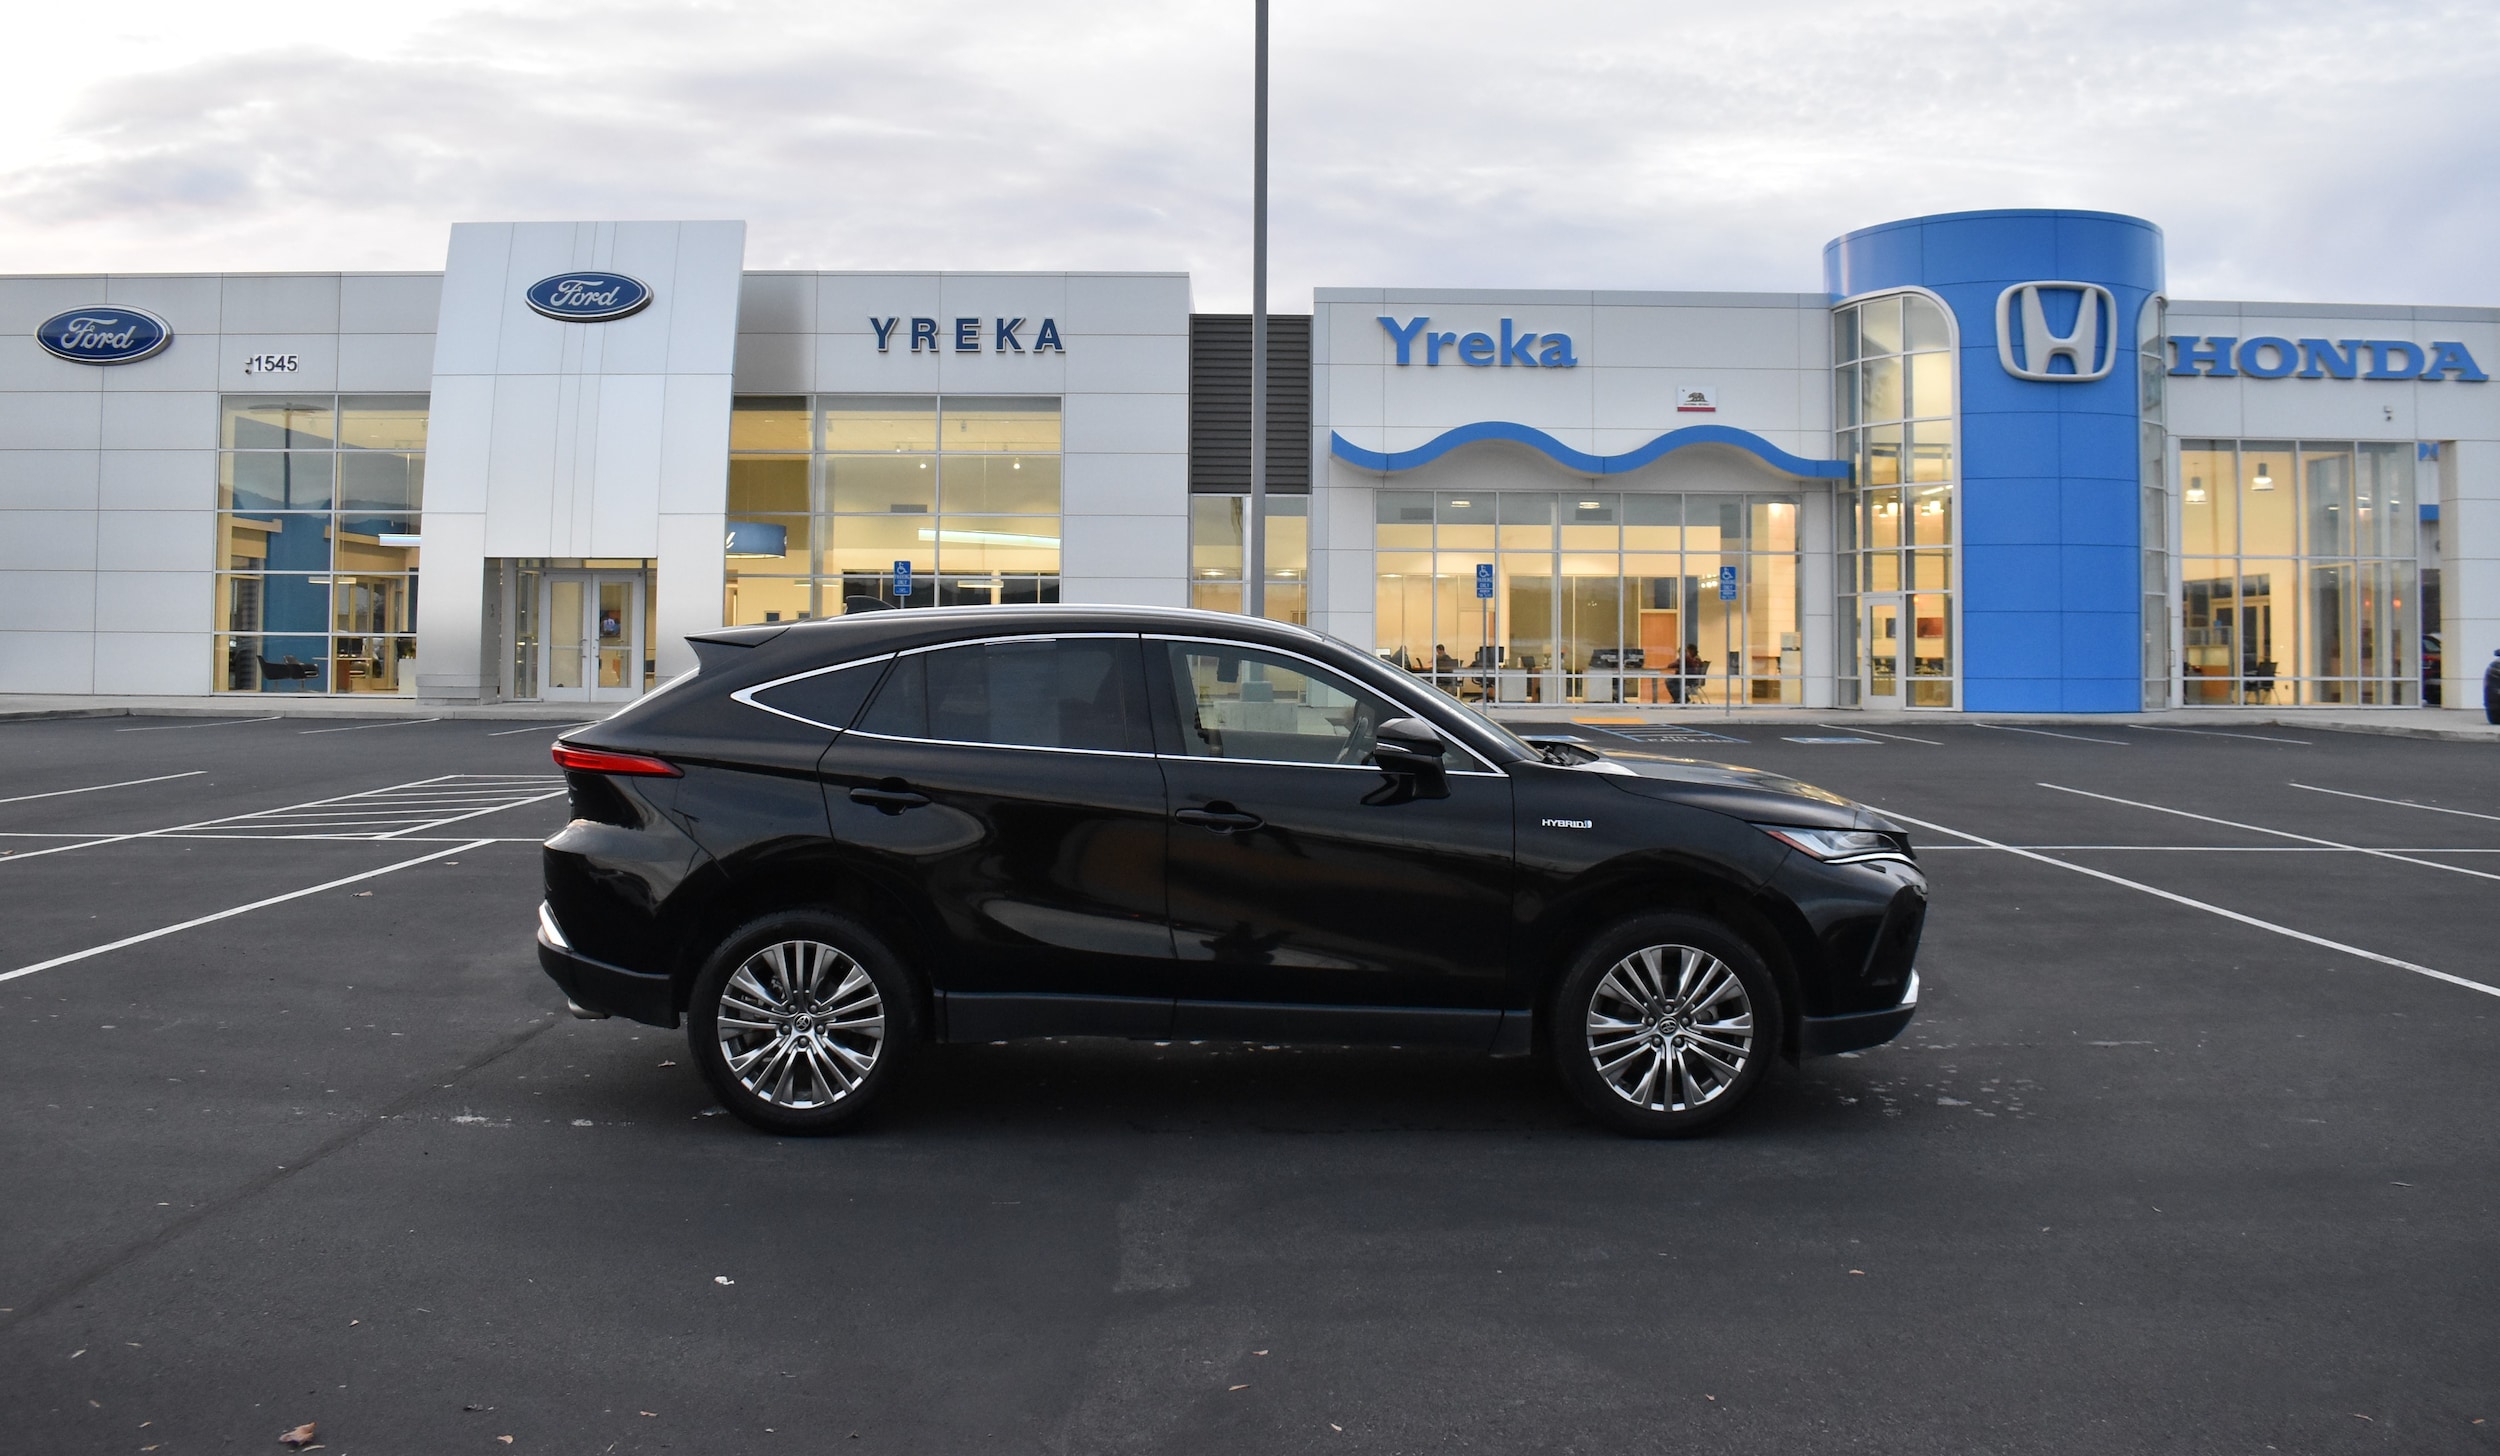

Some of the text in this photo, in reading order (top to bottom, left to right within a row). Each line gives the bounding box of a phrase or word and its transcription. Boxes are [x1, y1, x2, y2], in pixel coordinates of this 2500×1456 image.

[551, 279, 621, 306] Ford
[60, 317, 137, 349] Ford
[869, 316, 1065, 352] YREKA
[1377, 316, 1578, 367] Yreka
[254, 355, 298, 372] 1545
[2168, 335, 2490, 381] HONDA
[1541, 818, 1584, 828] HYBRID
